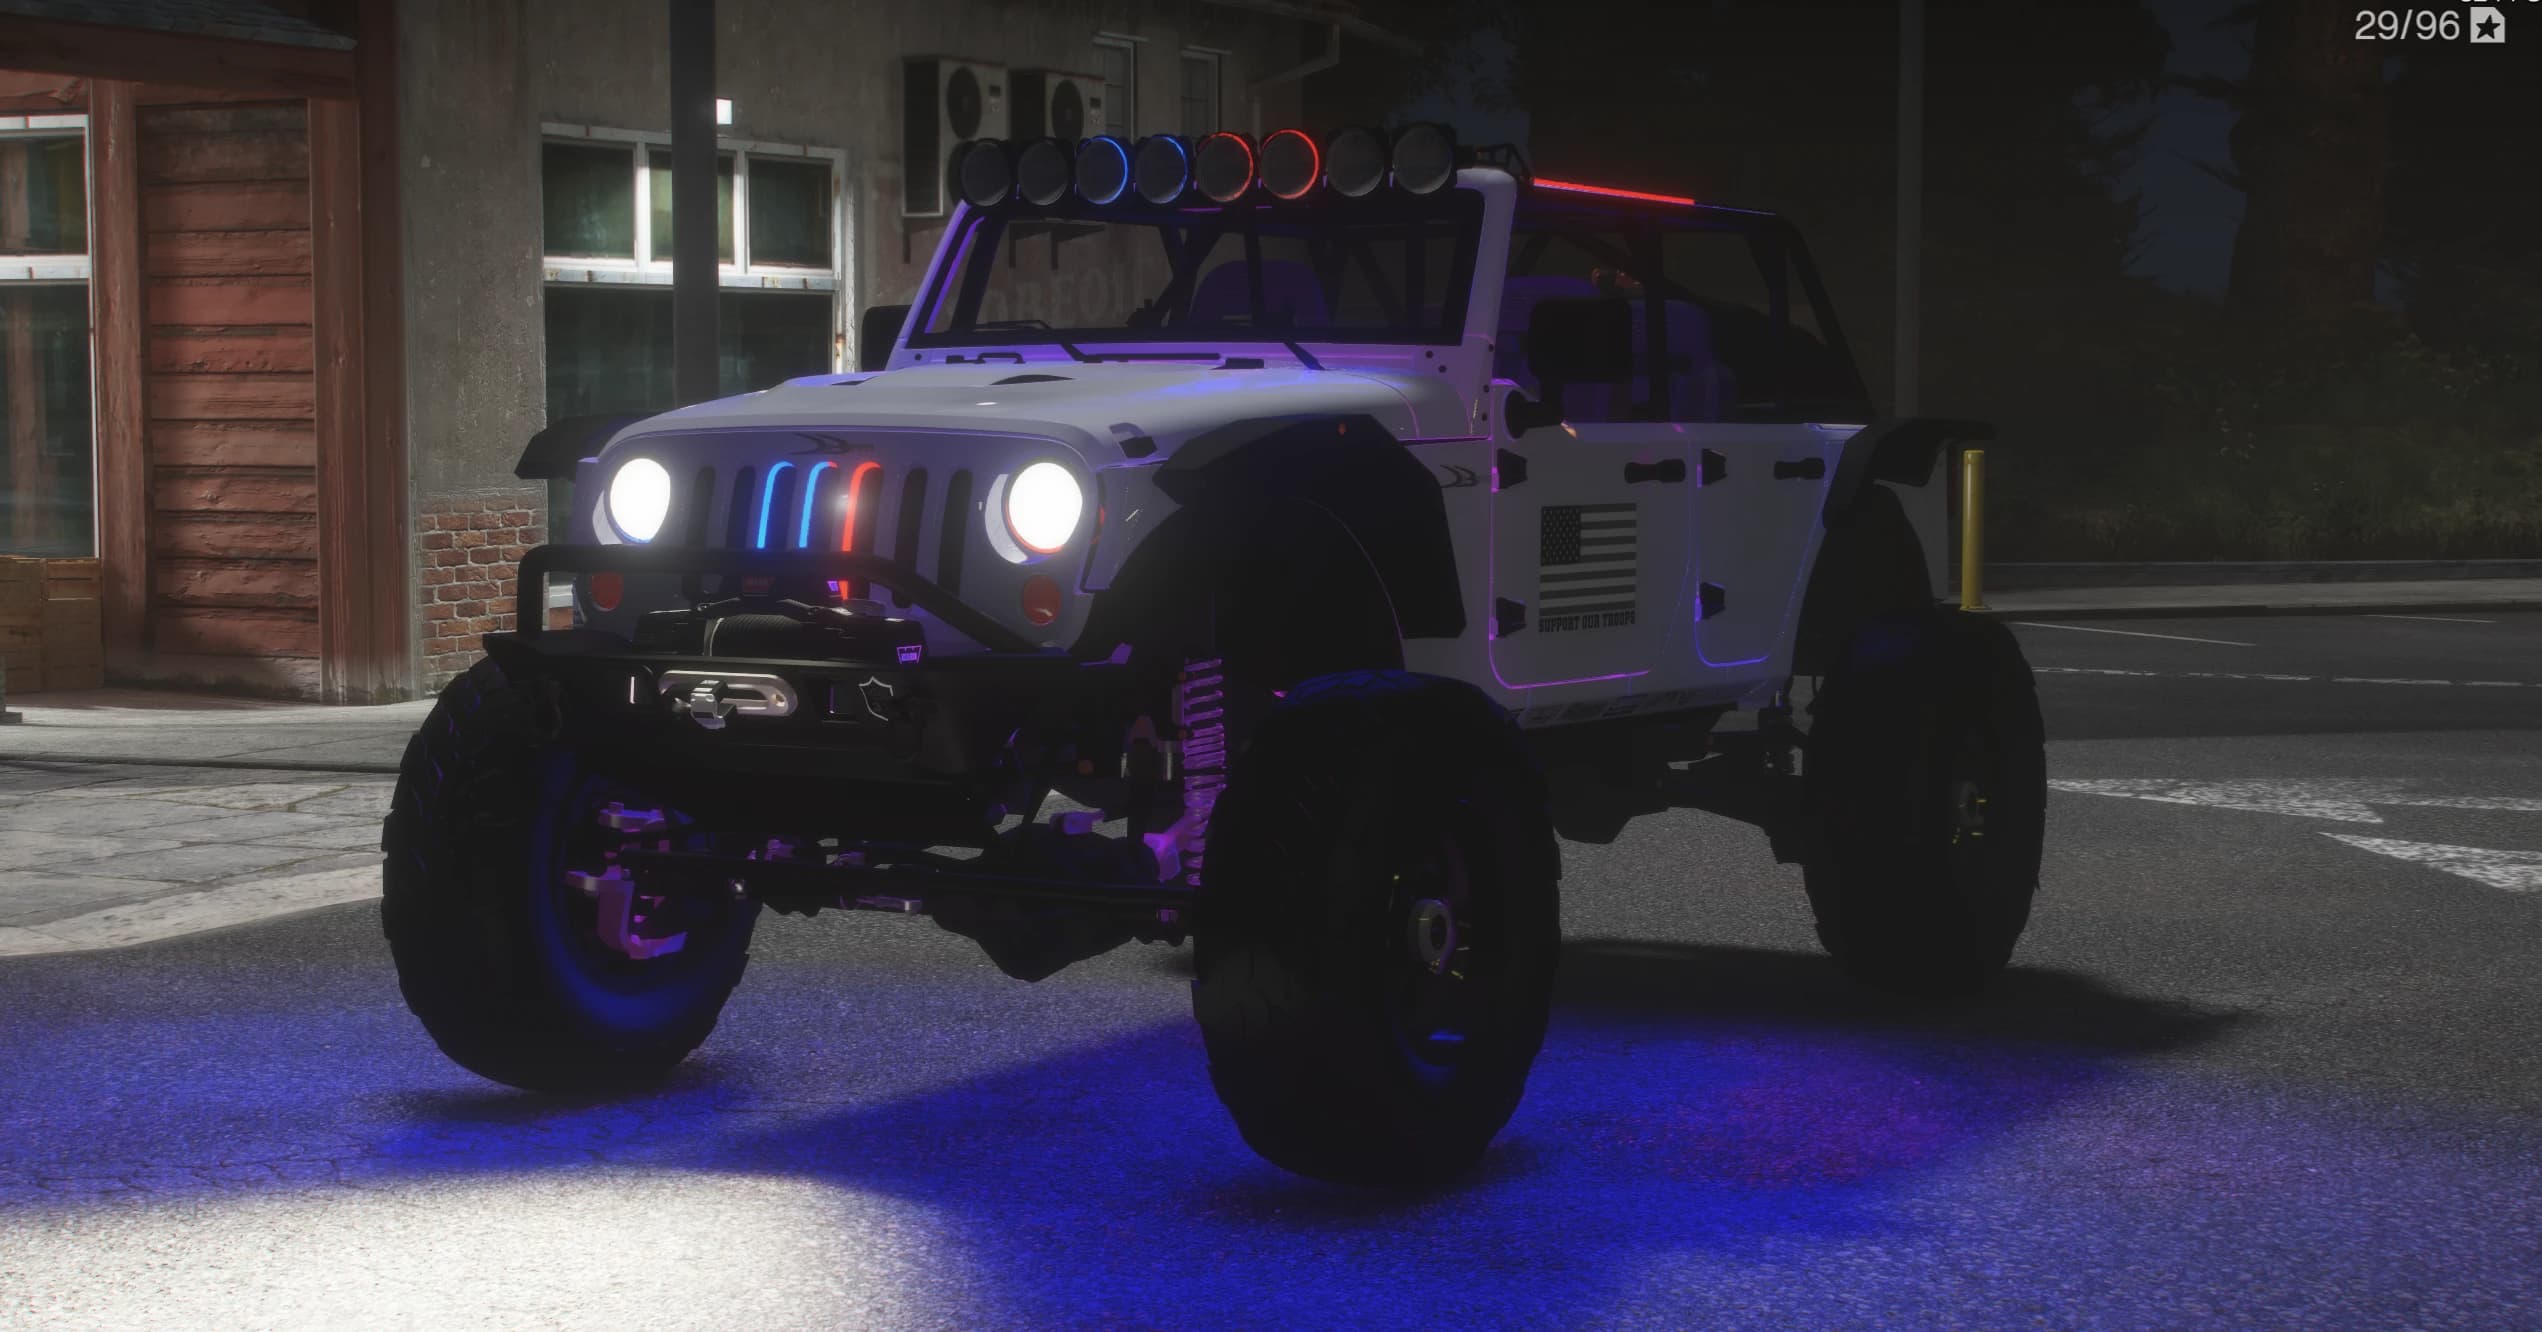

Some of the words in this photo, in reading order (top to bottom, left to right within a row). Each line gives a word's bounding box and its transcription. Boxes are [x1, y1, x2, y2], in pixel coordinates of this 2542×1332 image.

[1539, 616, 1580, 632] SUPPORT
[1582, 614, 1600, 629] OUR
[1602, 611, 1635, 626] TROOPS
